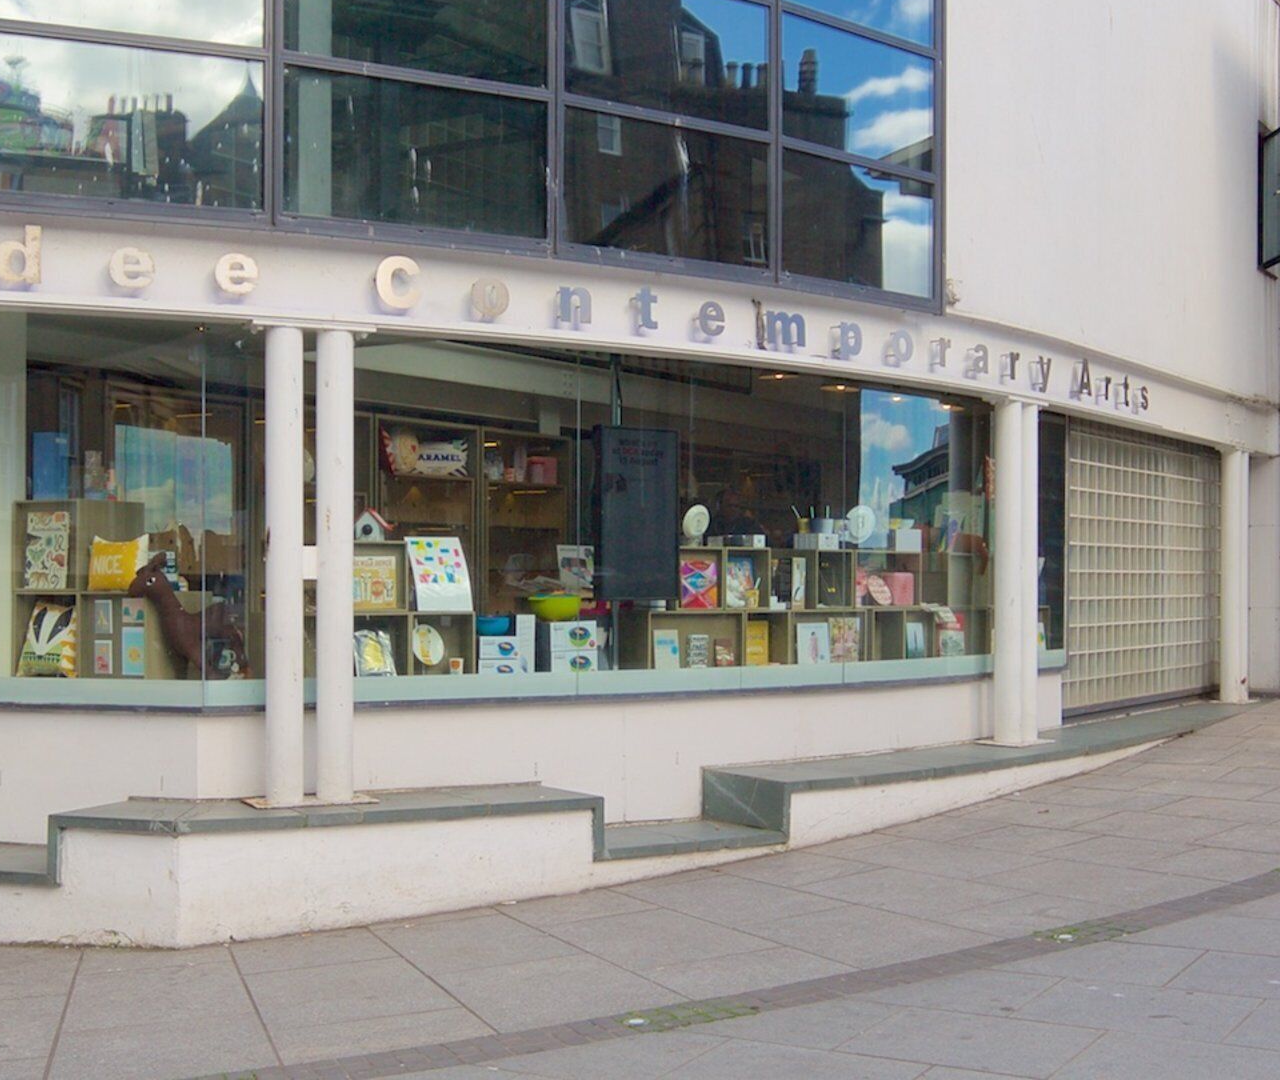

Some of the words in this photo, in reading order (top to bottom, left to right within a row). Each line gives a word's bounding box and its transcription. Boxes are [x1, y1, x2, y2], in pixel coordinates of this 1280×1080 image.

[374, 255, 1053, 394] Contemporary
[1078, 357, 1151, 412] Arts
[417, 453, 462, 462] ARAMEL
[93, 555, 123, 574] NICE
